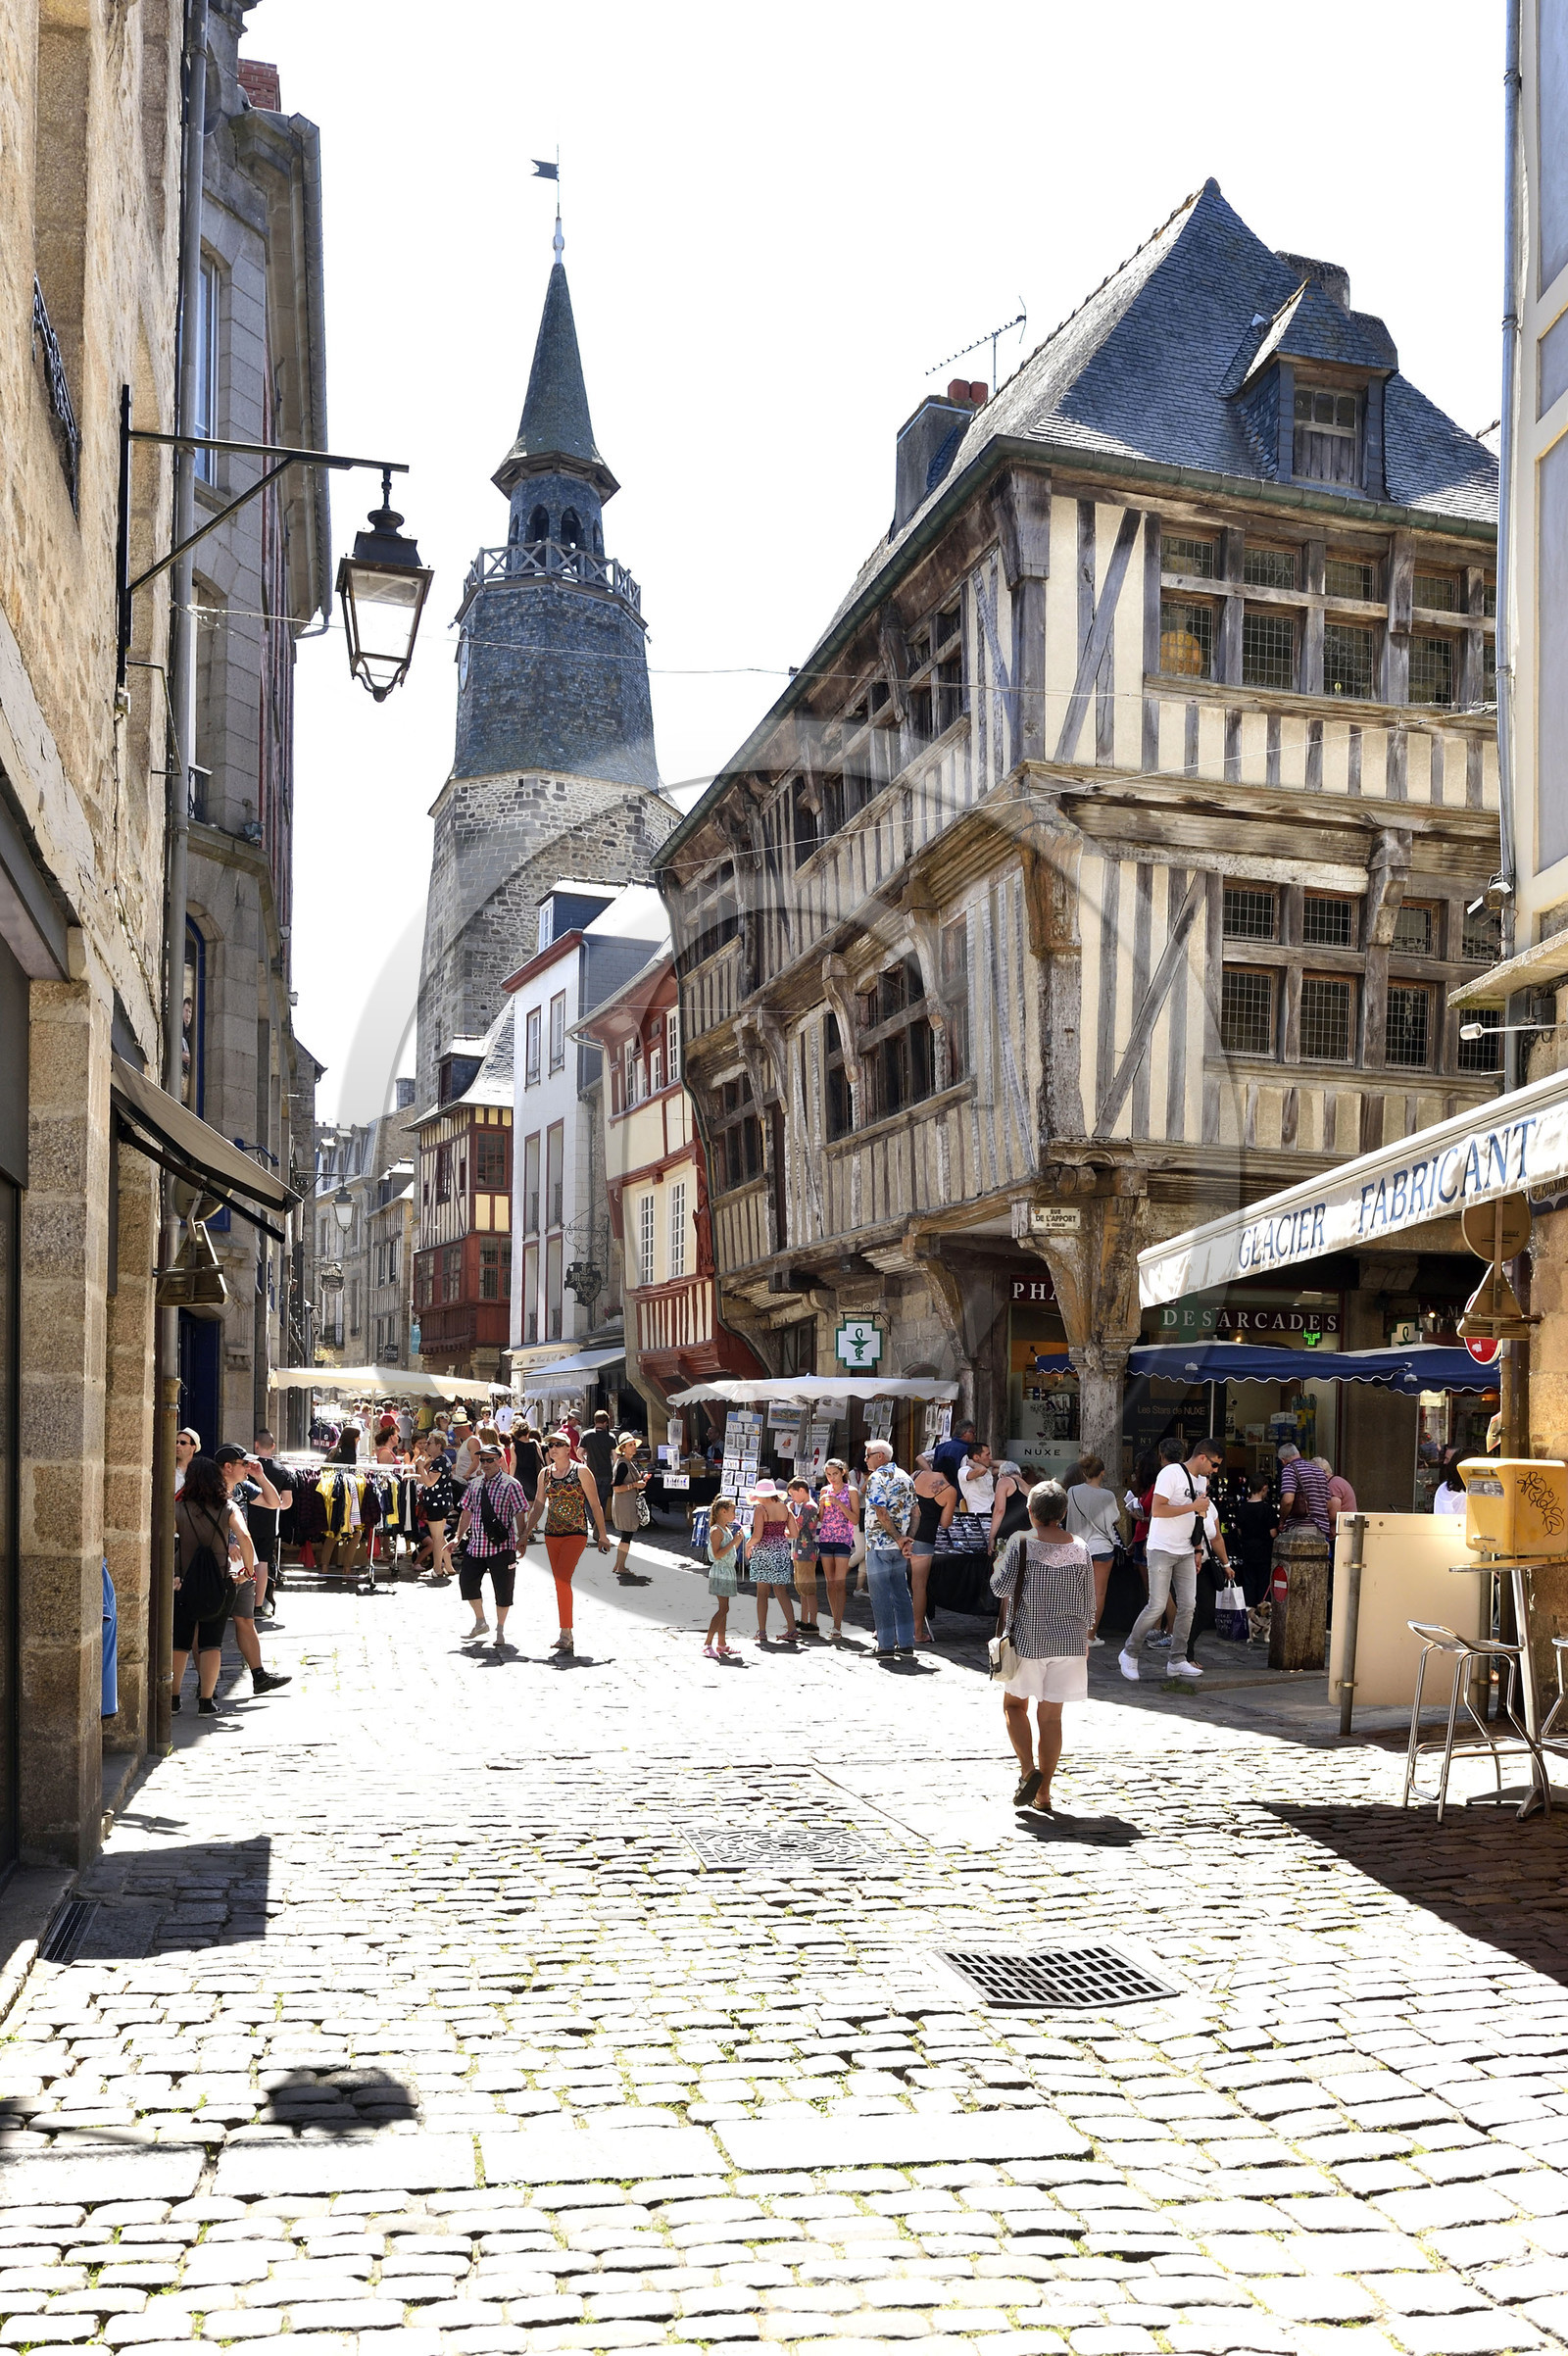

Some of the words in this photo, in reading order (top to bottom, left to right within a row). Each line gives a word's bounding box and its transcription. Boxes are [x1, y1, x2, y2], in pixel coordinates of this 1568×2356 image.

[1238, 1203, 1326, 1269] GLACIER
[1357, 1117, 1537, 1234] FABRICANT
[1162, 1309, 1212, 1327] DES
[1217, 1310, 1338, 1332] ARCADES
[1138, 1405, 1152, 1414] Les
[1152, 1405, 1171, 1415] Stars
[1172, 1406, 1182, 1415] de
[1183, 1406, 1206, 1416] NUXE
